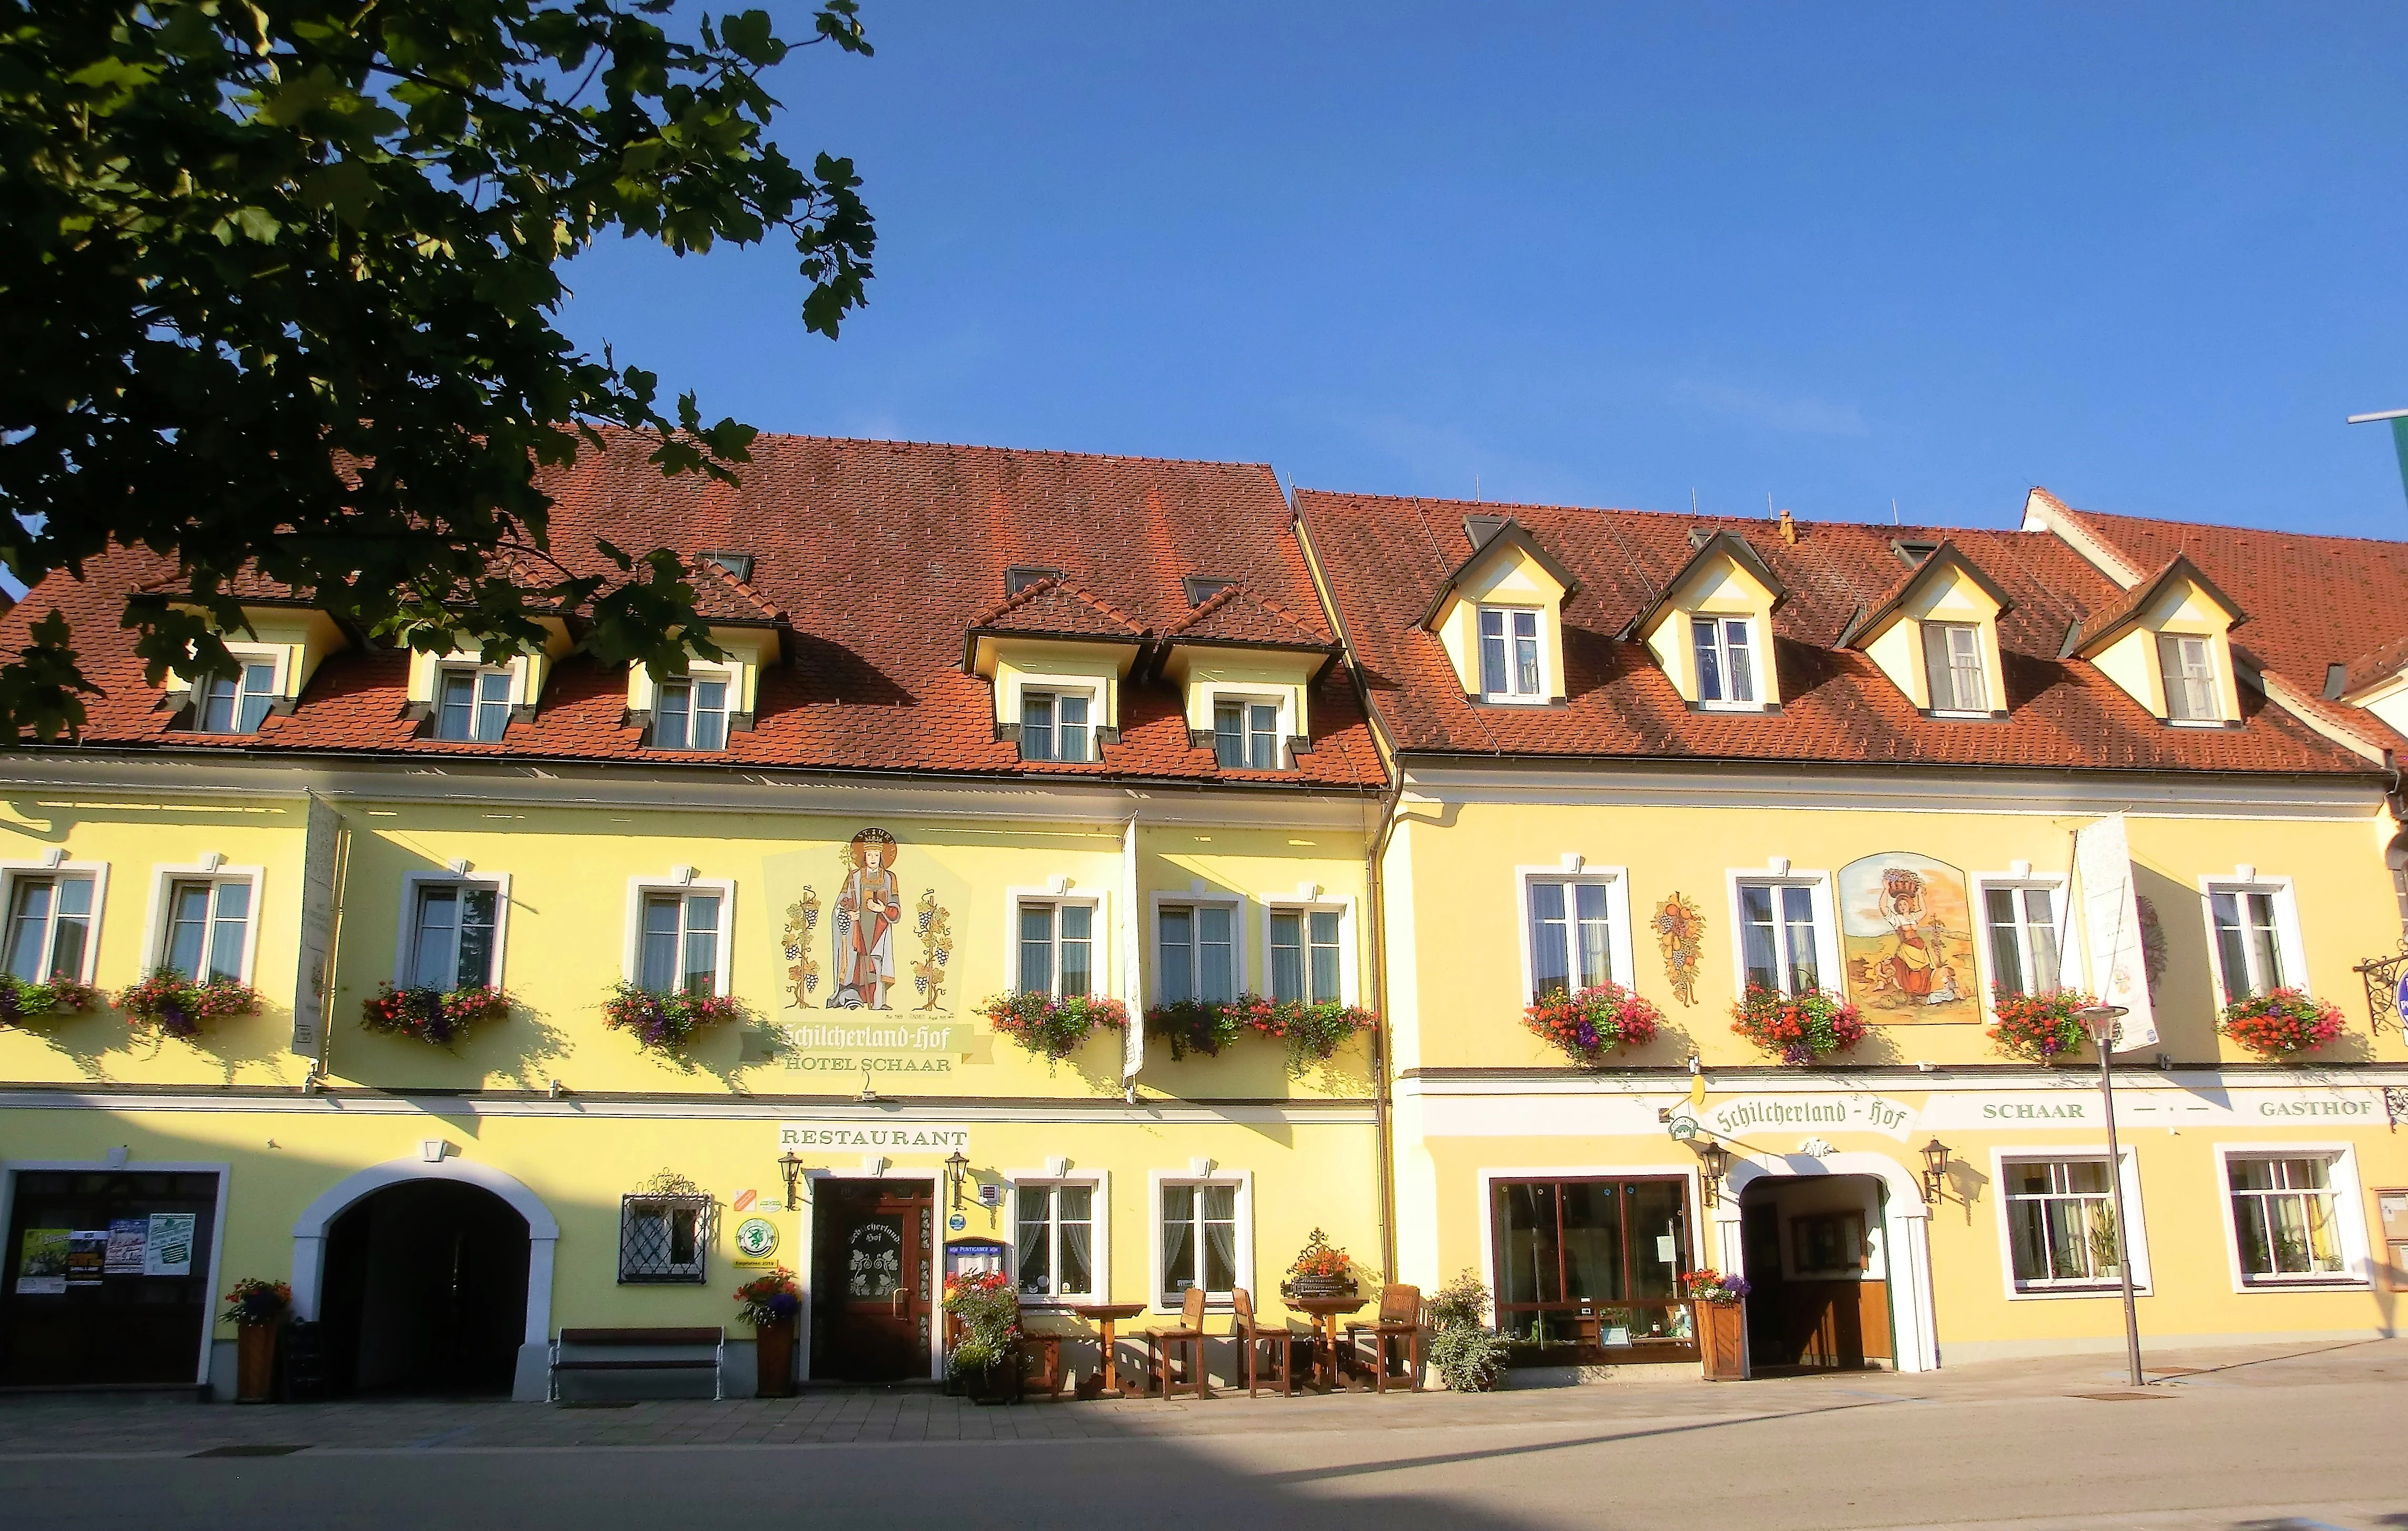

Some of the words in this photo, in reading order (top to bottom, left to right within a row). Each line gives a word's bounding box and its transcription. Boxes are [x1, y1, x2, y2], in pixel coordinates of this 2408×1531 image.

[785, 1058, 857, 1071] HOTEL
[861, 1059, 951, 1072] SCHAAR
[1717, 1100, 1846, 1132] Schilcherland
[1868, 1101, 1907, 1129] Hof
[1983, 1104, 2085, 1119] SCHAAR
[2260, 1101, 2372, 1117] GASTHOF
[782, 1130, 967, 1145] RESTAURANT
